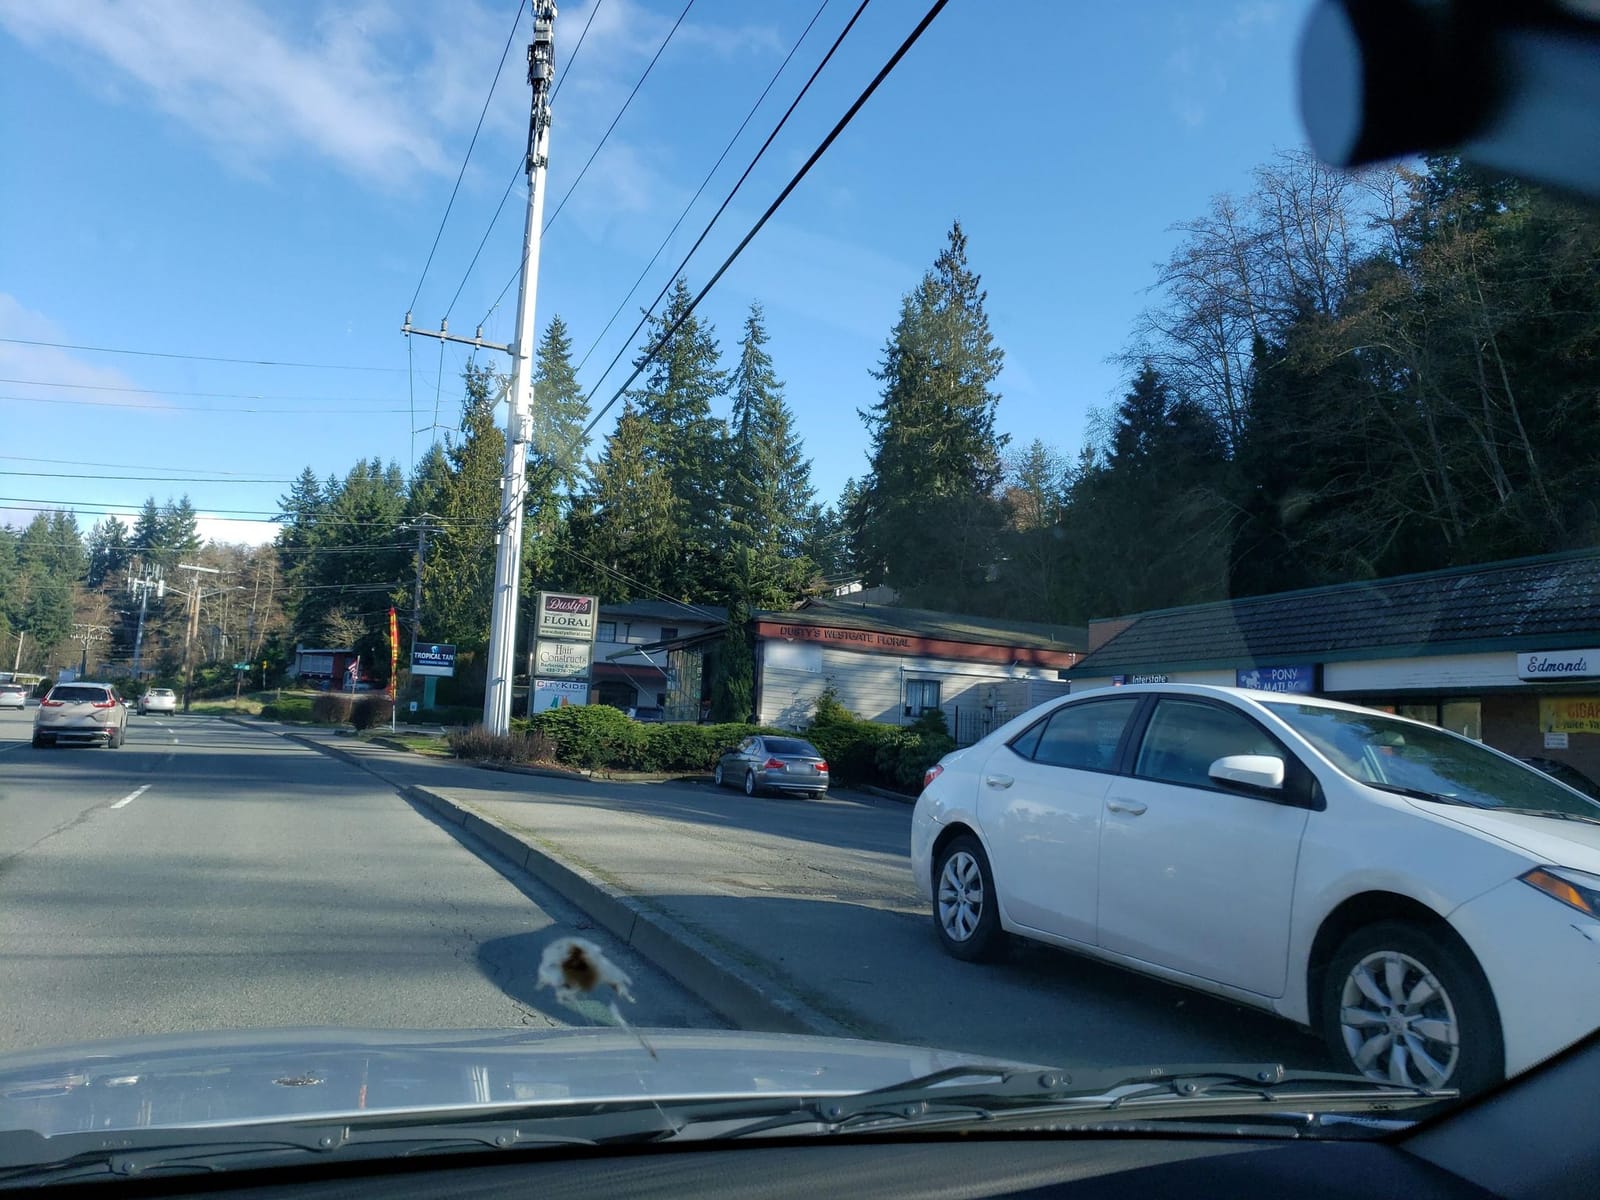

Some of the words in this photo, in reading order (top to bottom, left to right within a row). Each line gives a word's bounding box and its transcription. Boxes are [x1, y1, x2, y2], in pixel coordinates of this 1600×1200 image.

[547, 598, 588, 612] Dusty's
[544, 615, 590, 627] FLORAL
[780, 626, 821, 638] DUSTY'S
[824, 629, 873, 643] WESTGATE
[877, 635, 912, 647] FLORAL
[555, 644, 574, 656] Hair
[414, 652, 441, 660] TROPICAL
[442, 652, 454, 661] TAN
[540, 651, 586, 664] Constructs
[1527, 656, 1587, 672] Edmonds
[1132, 674, 1167, 684] Interstate
[1271, 668, 1298, 681] PONY
